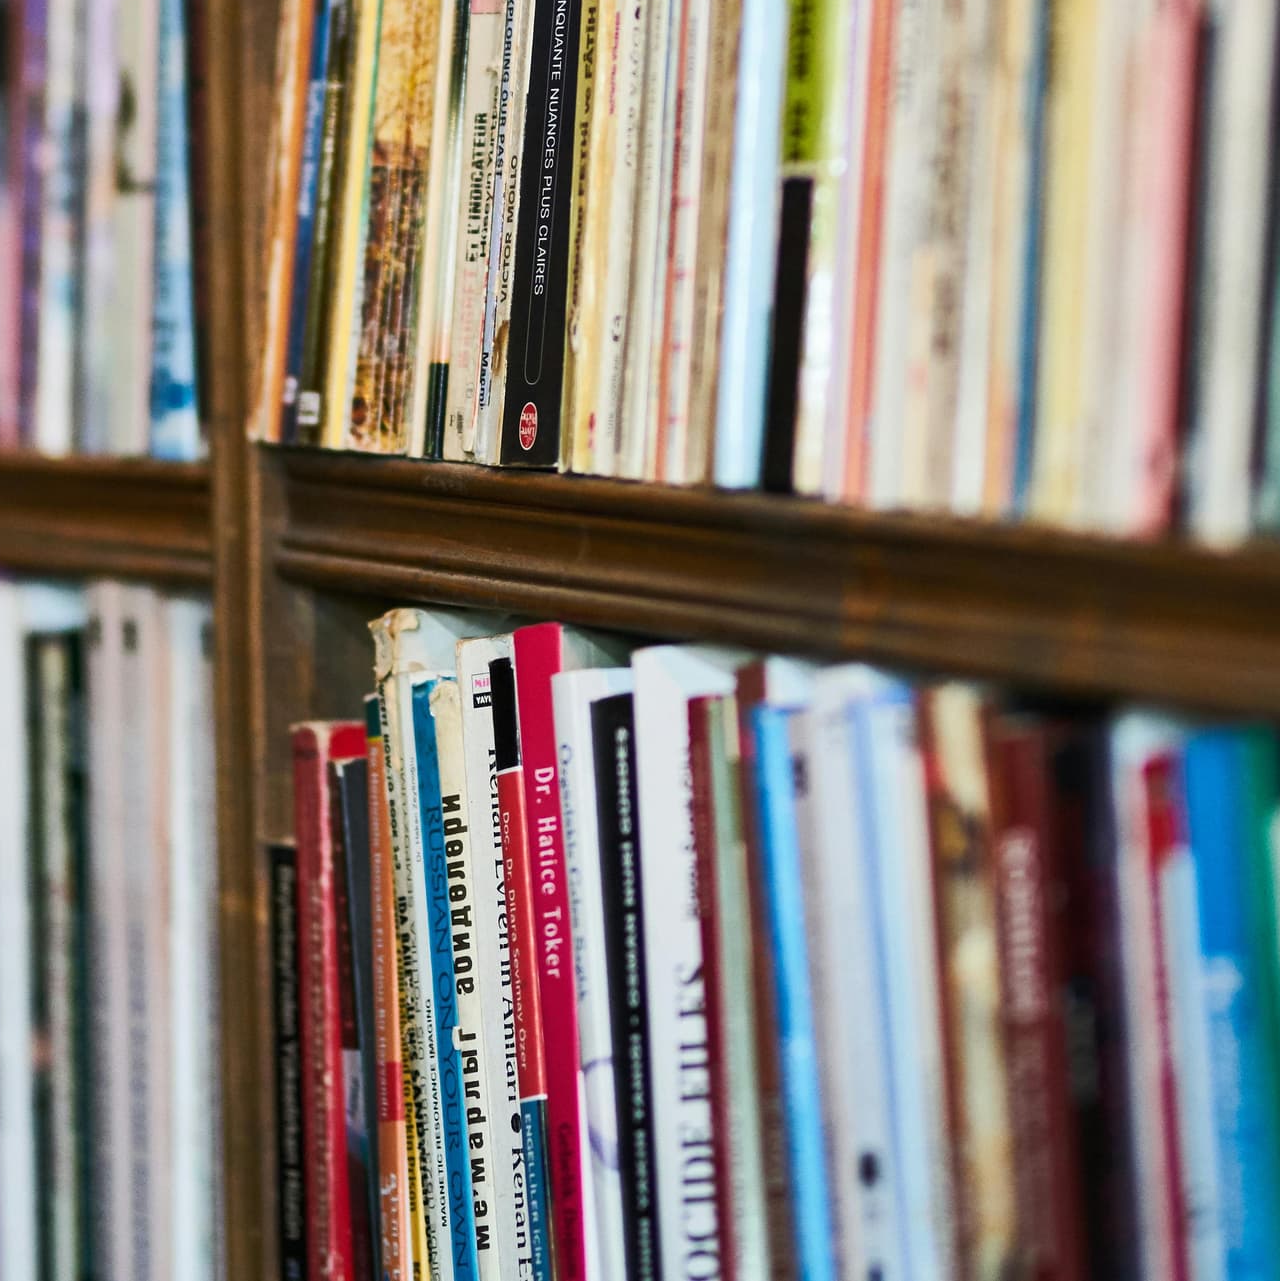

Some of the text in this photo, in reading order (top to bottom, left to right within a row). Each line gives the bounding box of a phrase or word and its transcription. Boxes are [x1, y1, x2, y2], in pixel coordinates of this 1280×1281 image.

[500, 90, 508, 127] OUR
[545, 88, 559, 169] NUANCES
[495, 134, 505, 179] PAST
[500, 155, 517, 303] VICTOR MOLLO
[541, 176, 552, 219] PLUS
[535, 225, 548, 296] CLAIRES
[535, 766, 561, 978] Dr. Hatice Toker
[397, 896, 408, 926] IDA
[509, 889, 517, 942] Dilara
[512, 948, 522, 1022] Sevimay
[430, 805, 468, 1271] RUSSIAN ON YOUR OWN
[519, 1028, 527, 1070] Özer
[426, 999, 447, 1227] MAGNETIC RESONANCE IMAGING
[512, 1147, 526, 1249] Kenan
[524, 1113, 543, 1264] ENGELLİLER İÇİN
